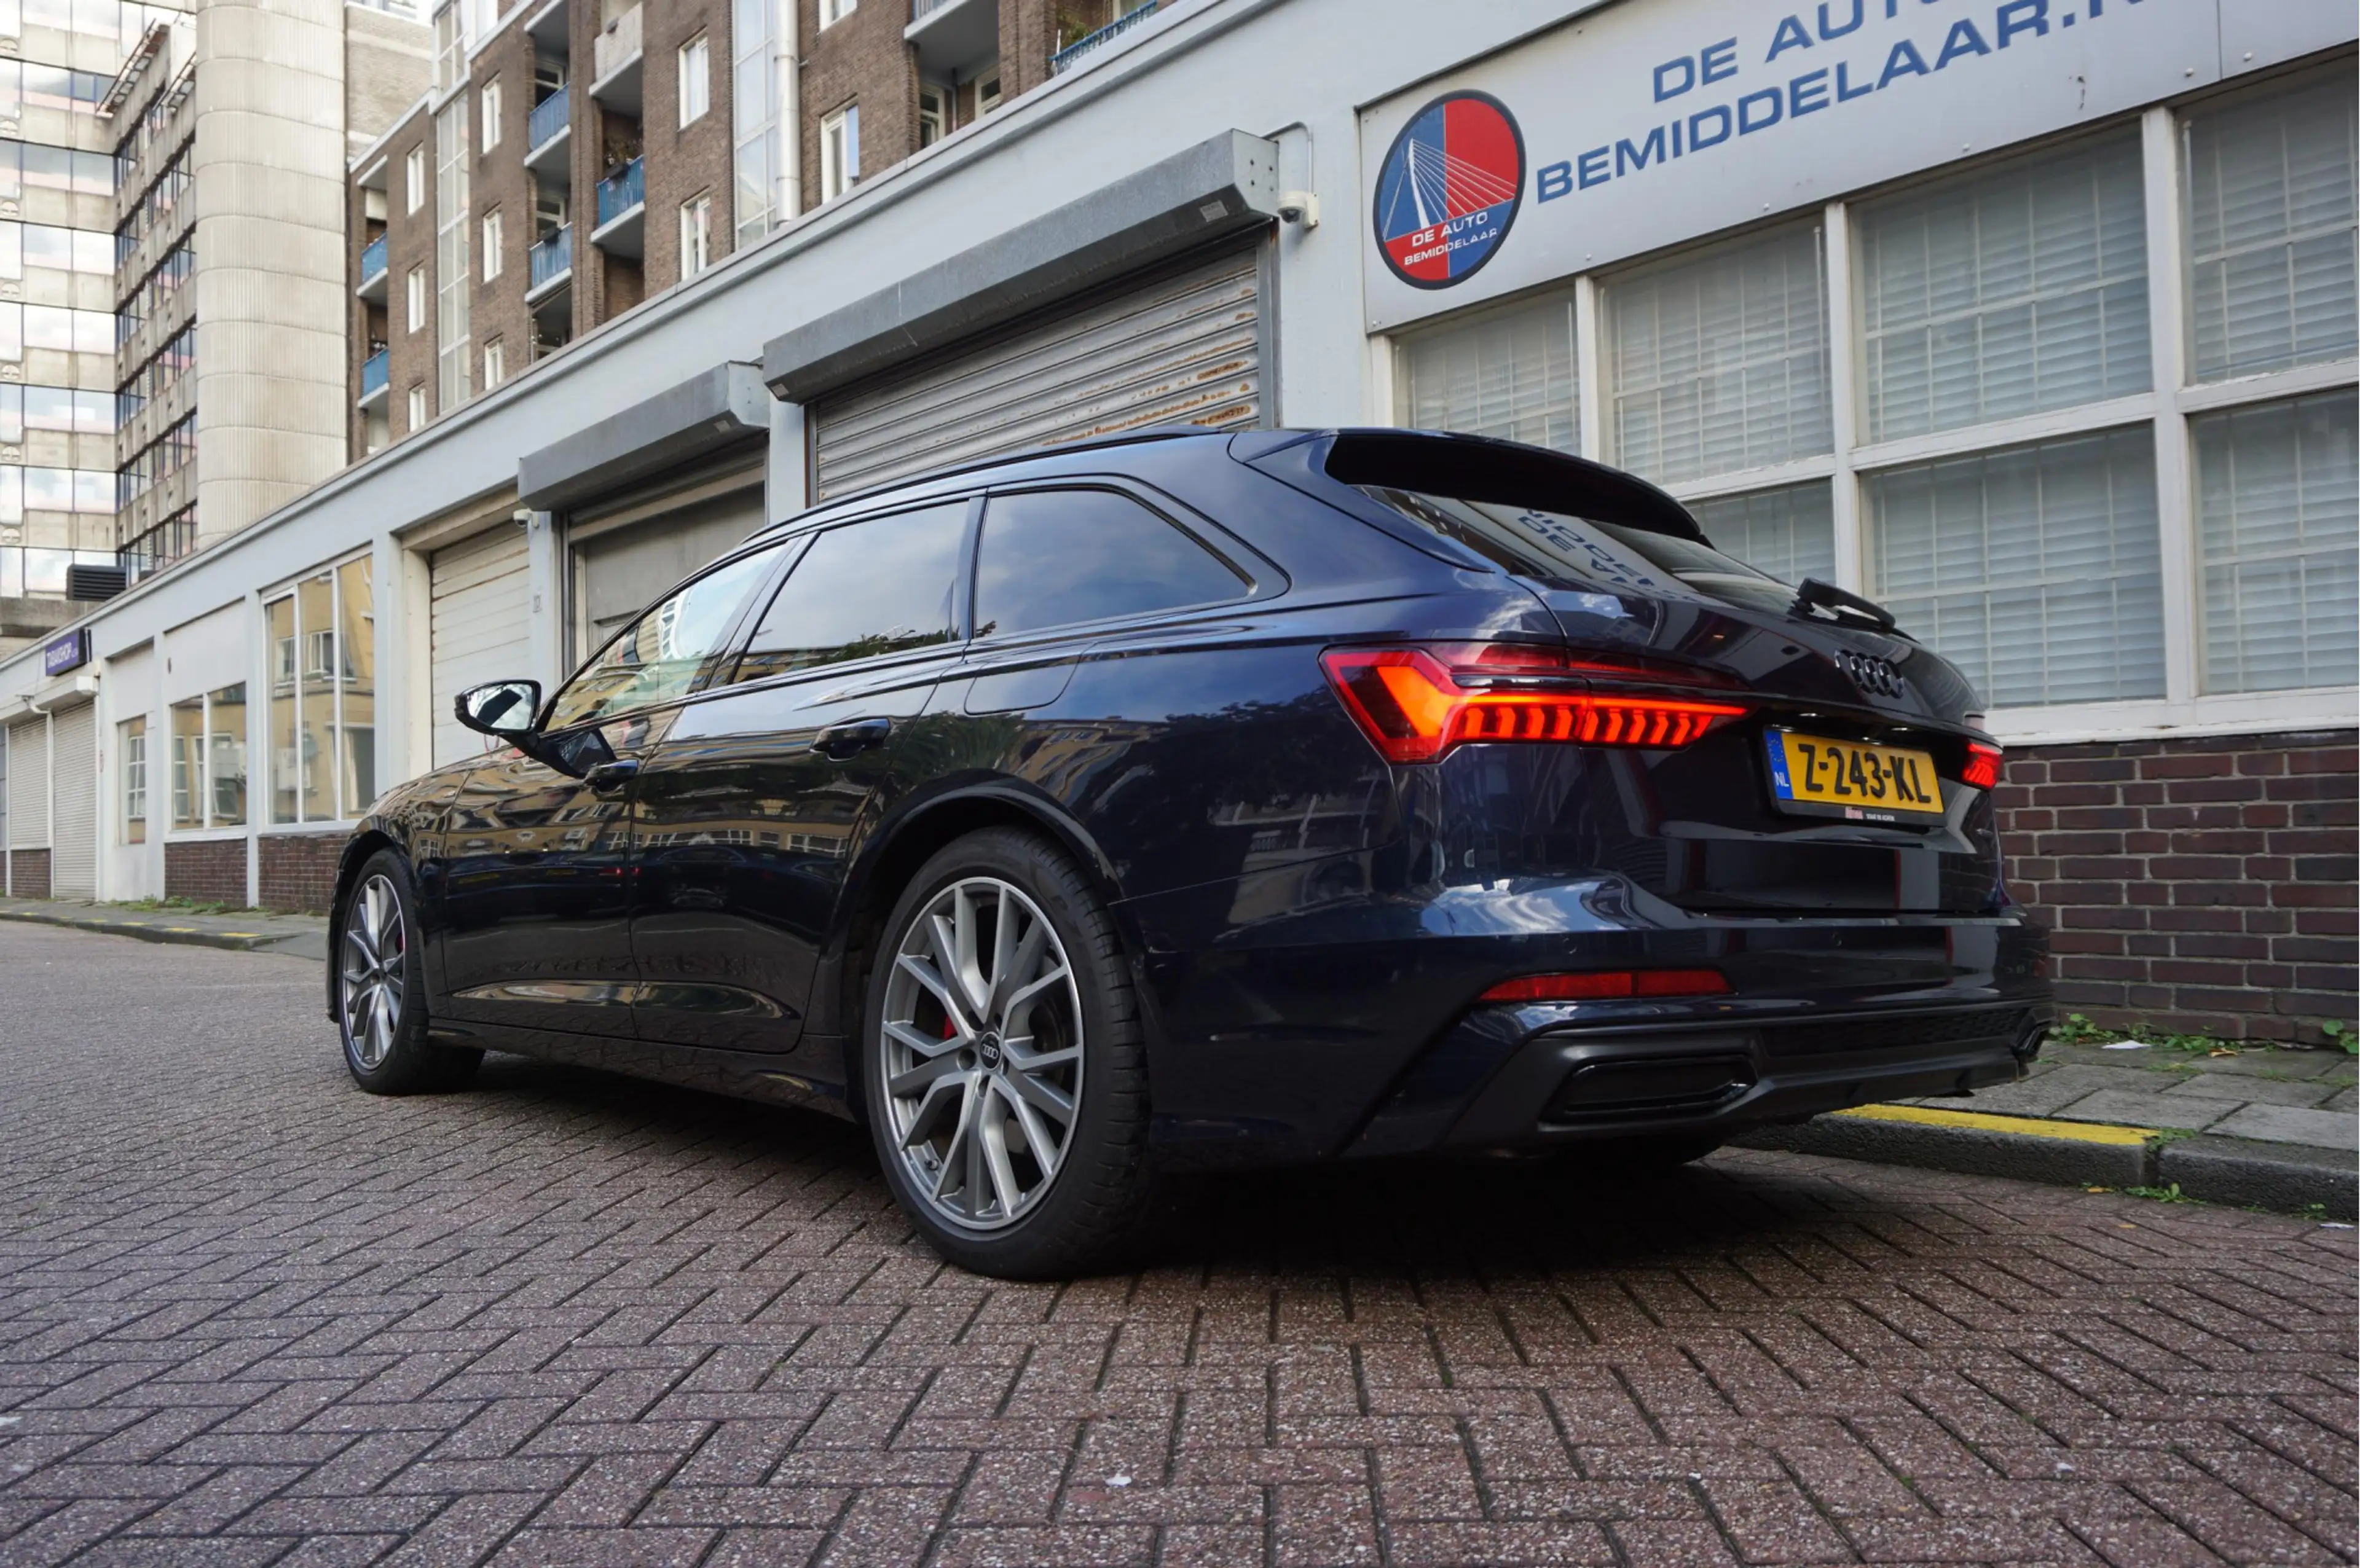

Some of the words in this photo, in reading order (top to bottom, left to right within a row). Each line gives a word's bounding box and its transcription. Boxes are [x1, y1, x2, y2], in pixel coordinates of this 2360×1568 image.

[1653, 36, 1739, 104] DE
[1404, 228, 1498, 265] BEMIDDELAAR
[1412, 229, 1435, 248] DE
[1441, 211, 1489, 238] AUTO
[1774, 771, 1790, 787] NL
[1798, 743, 1932, 803] Z-243-KL
